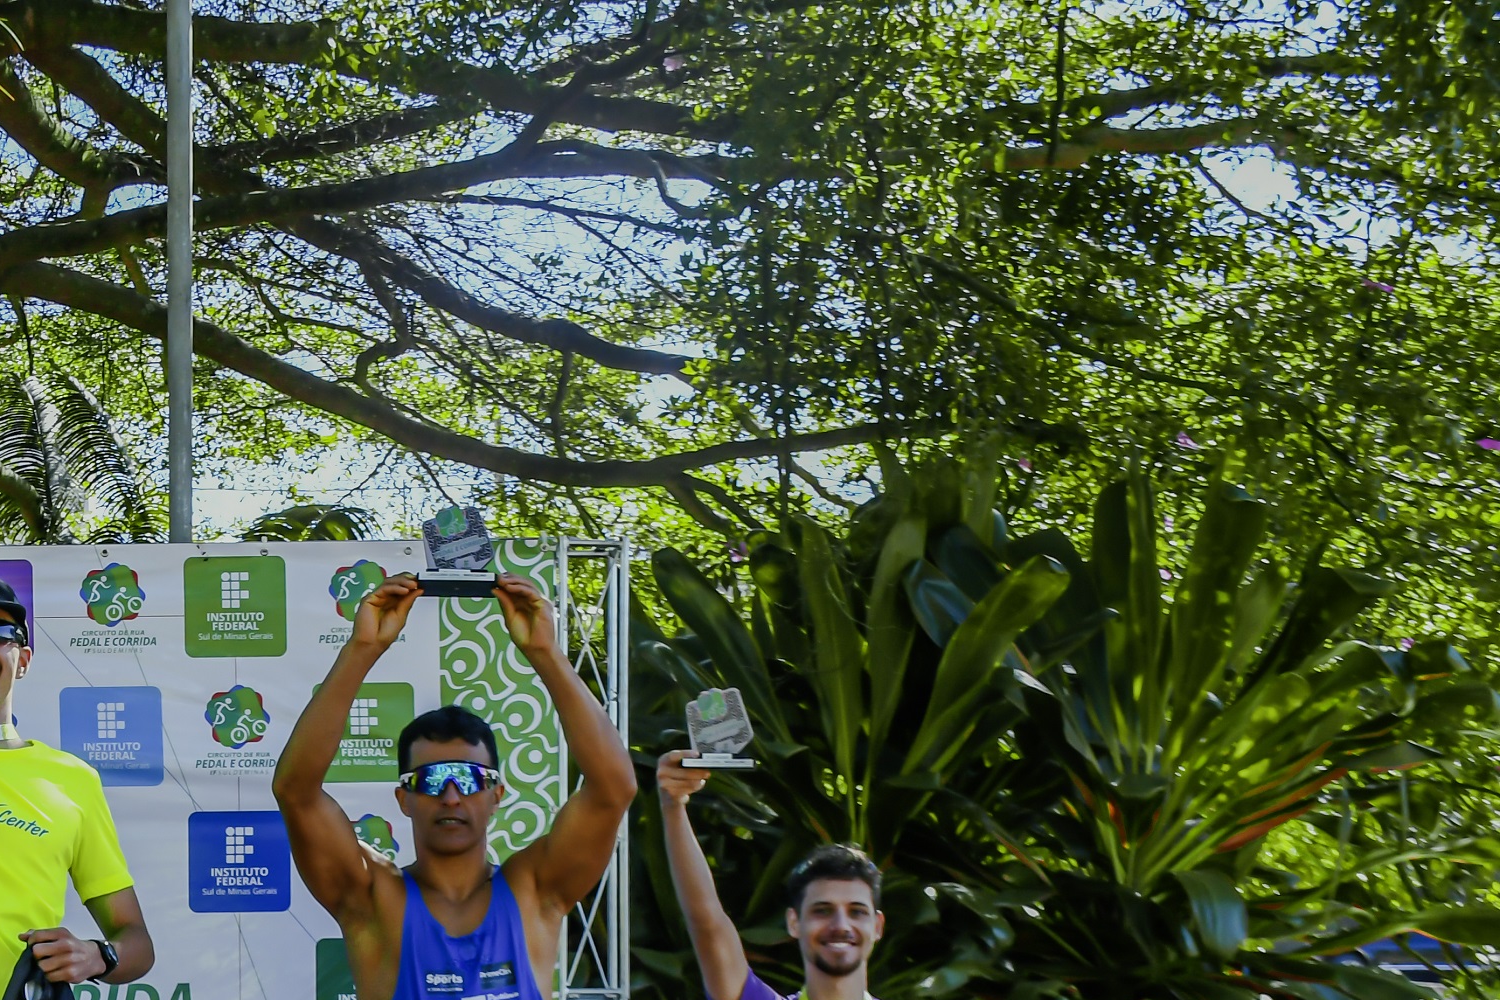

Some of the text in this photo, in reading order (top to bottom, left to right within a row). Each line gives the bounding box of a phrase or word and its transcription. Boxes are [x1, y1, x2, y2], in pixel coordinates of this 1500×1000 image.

[207, 612, 264, 622] INSTITUTO
[212, 621, 259, 631] FEDERAL
[199, 633, 210, 641] Sul
[248, 632, 273, 640] Gerais
[70, 637, 157, 647] PEDAL E CORRIDA
[84, 742, 140, 752] INSTITUTO
[340, 738, 393, 748] NSTITUTO
[89, 751, 135, 761] FEDERAL
[341, 747, 388, 757] FEDERAL
[196, 759, 276, 768] PEDAL E CORRID
[211, 867, 268, 877] INSTITUTO
[216, 876, 263, 886] FEDERAL
[203, 888, 214, 896] Sul
[217, 888, 226, 896] de
[253, 887, 277, 895] Gerais
[426, 974, 463, 985] Sports
